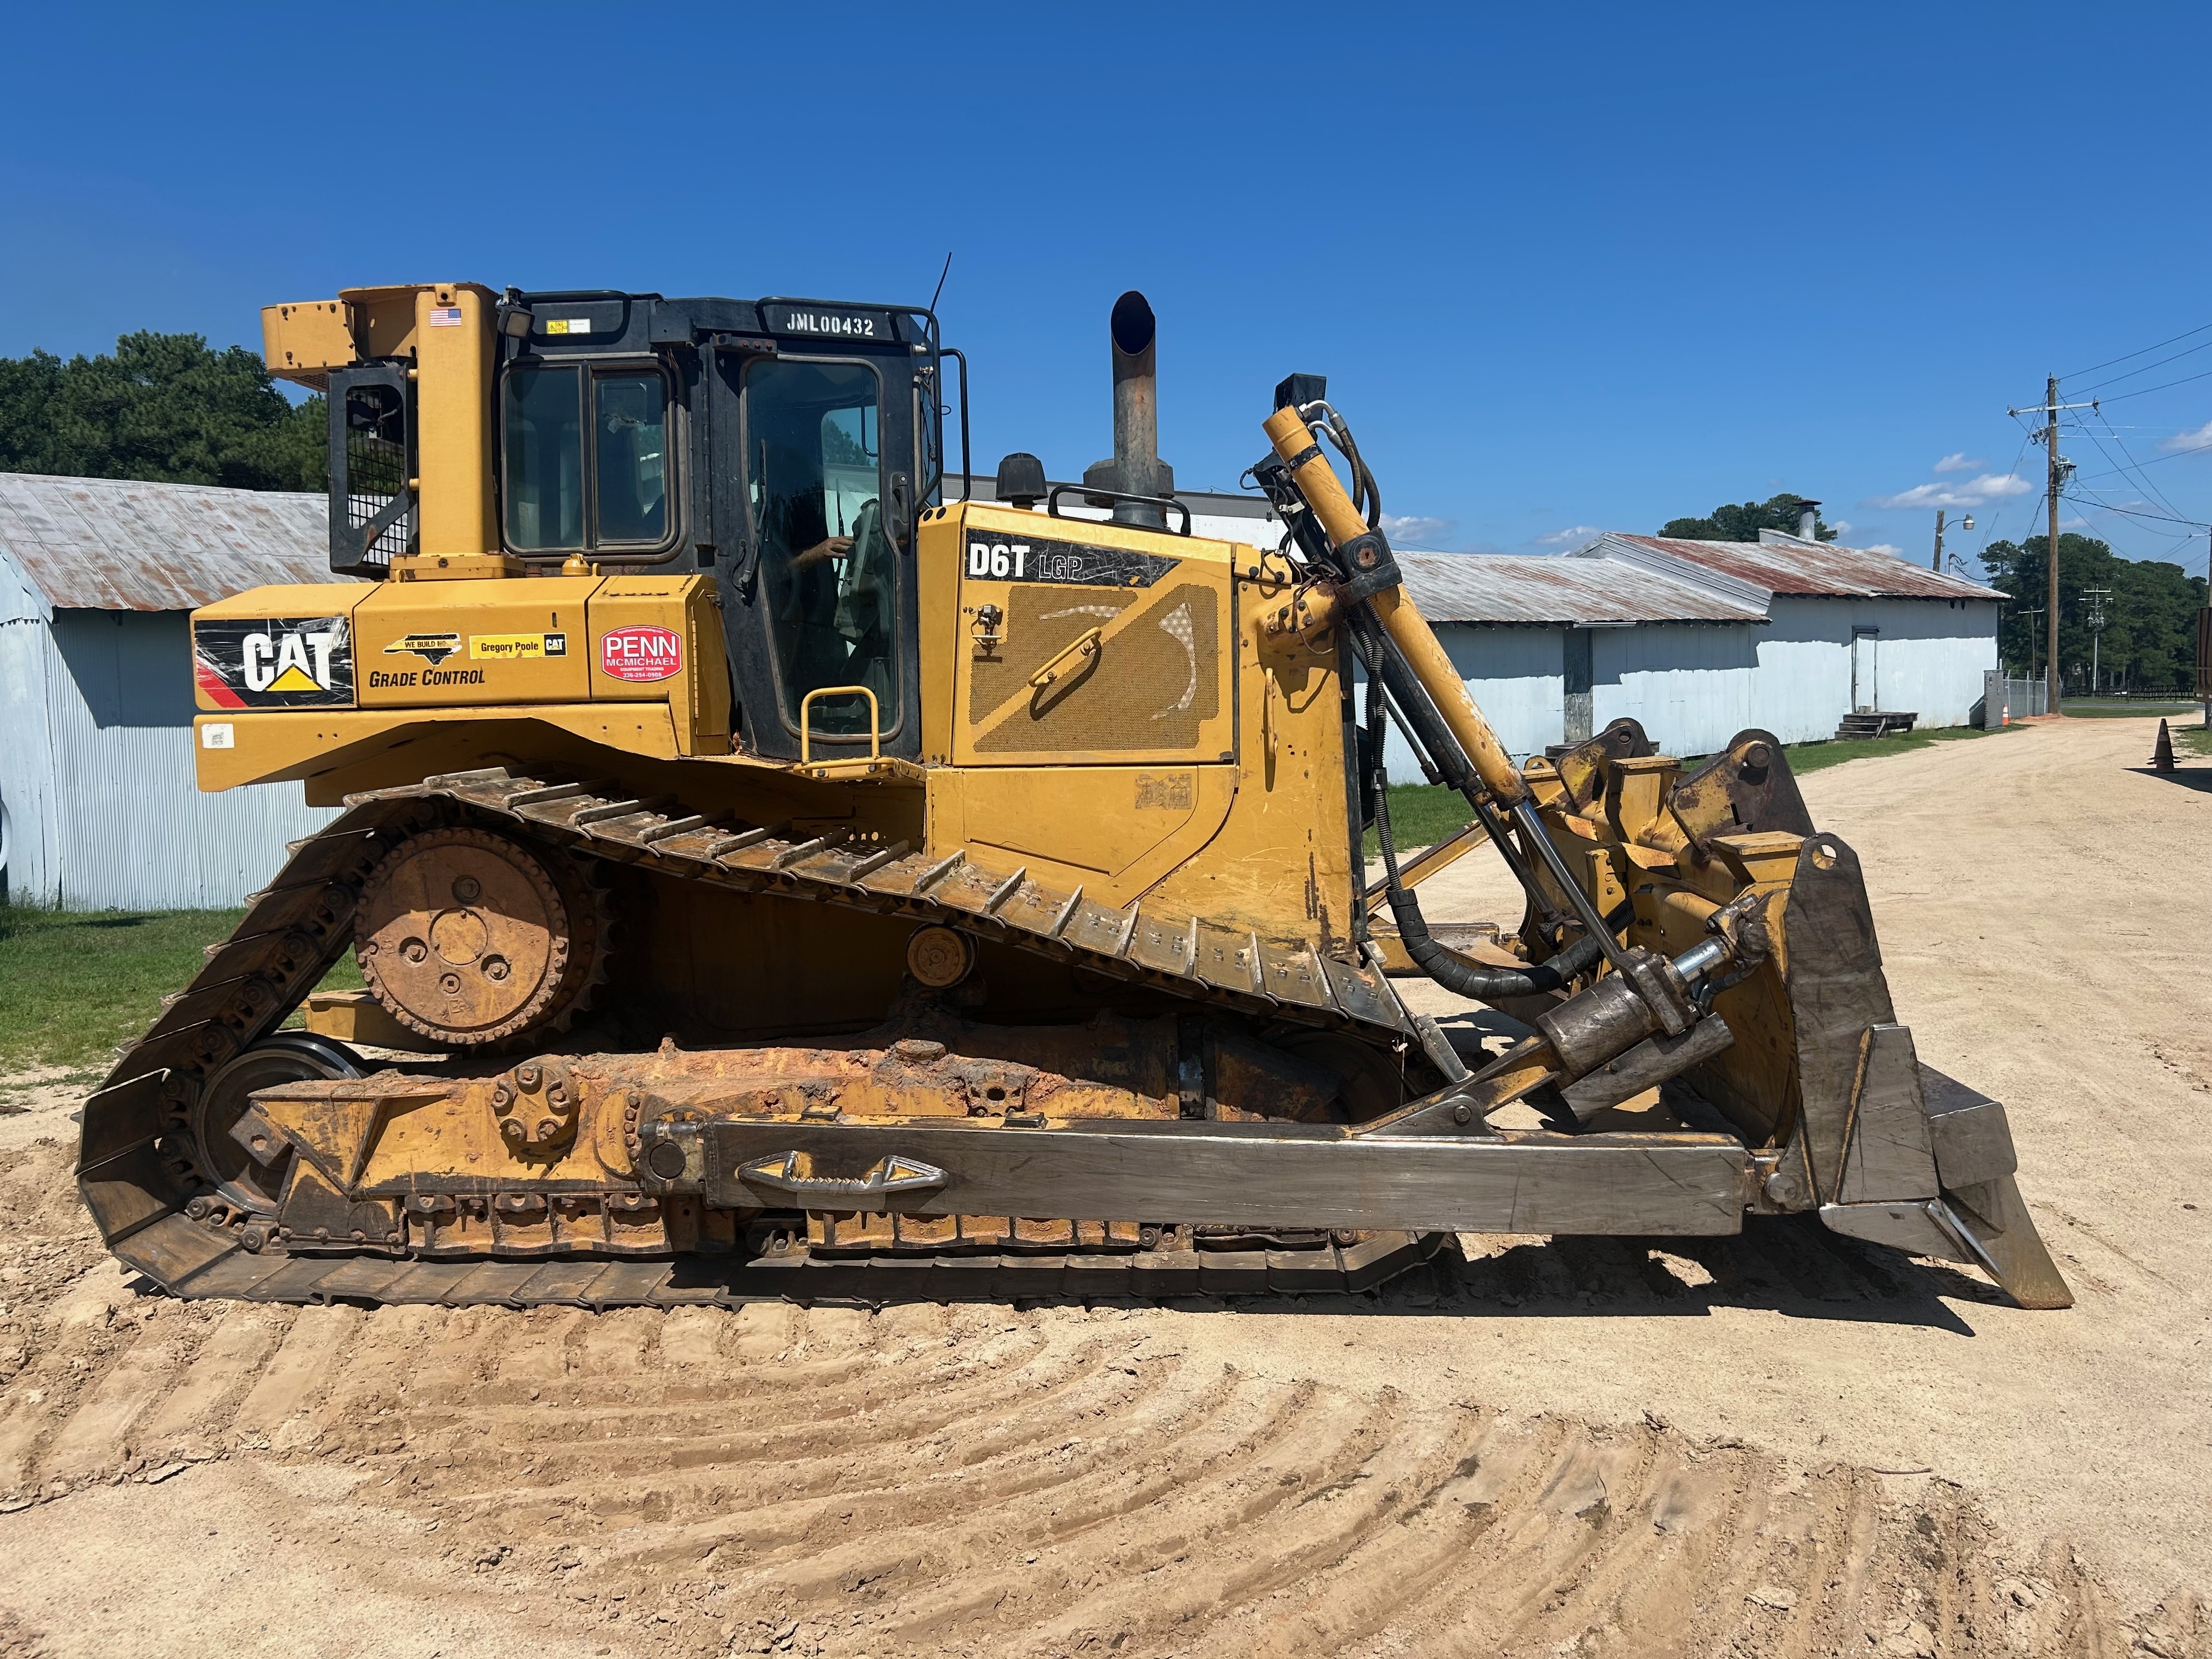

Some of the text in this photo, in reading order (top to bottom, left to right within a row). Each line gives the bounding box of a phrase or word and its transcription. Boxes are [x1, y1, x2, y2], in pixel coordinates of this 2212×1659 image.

[787, 313, 873, 336] JML00432
[969, 543, 1082, 579] D6T LGP
[481, 641, 539, 653] Gregory Poole
[545, 639, 563, 651] CAT
[606, 636, 676, 658] PENN
[242, 633, 334, 692] CAT
[606, 657, 677, 667] MCMICHAEL
[369, 669, 485, 687] GRADE CONTROL
